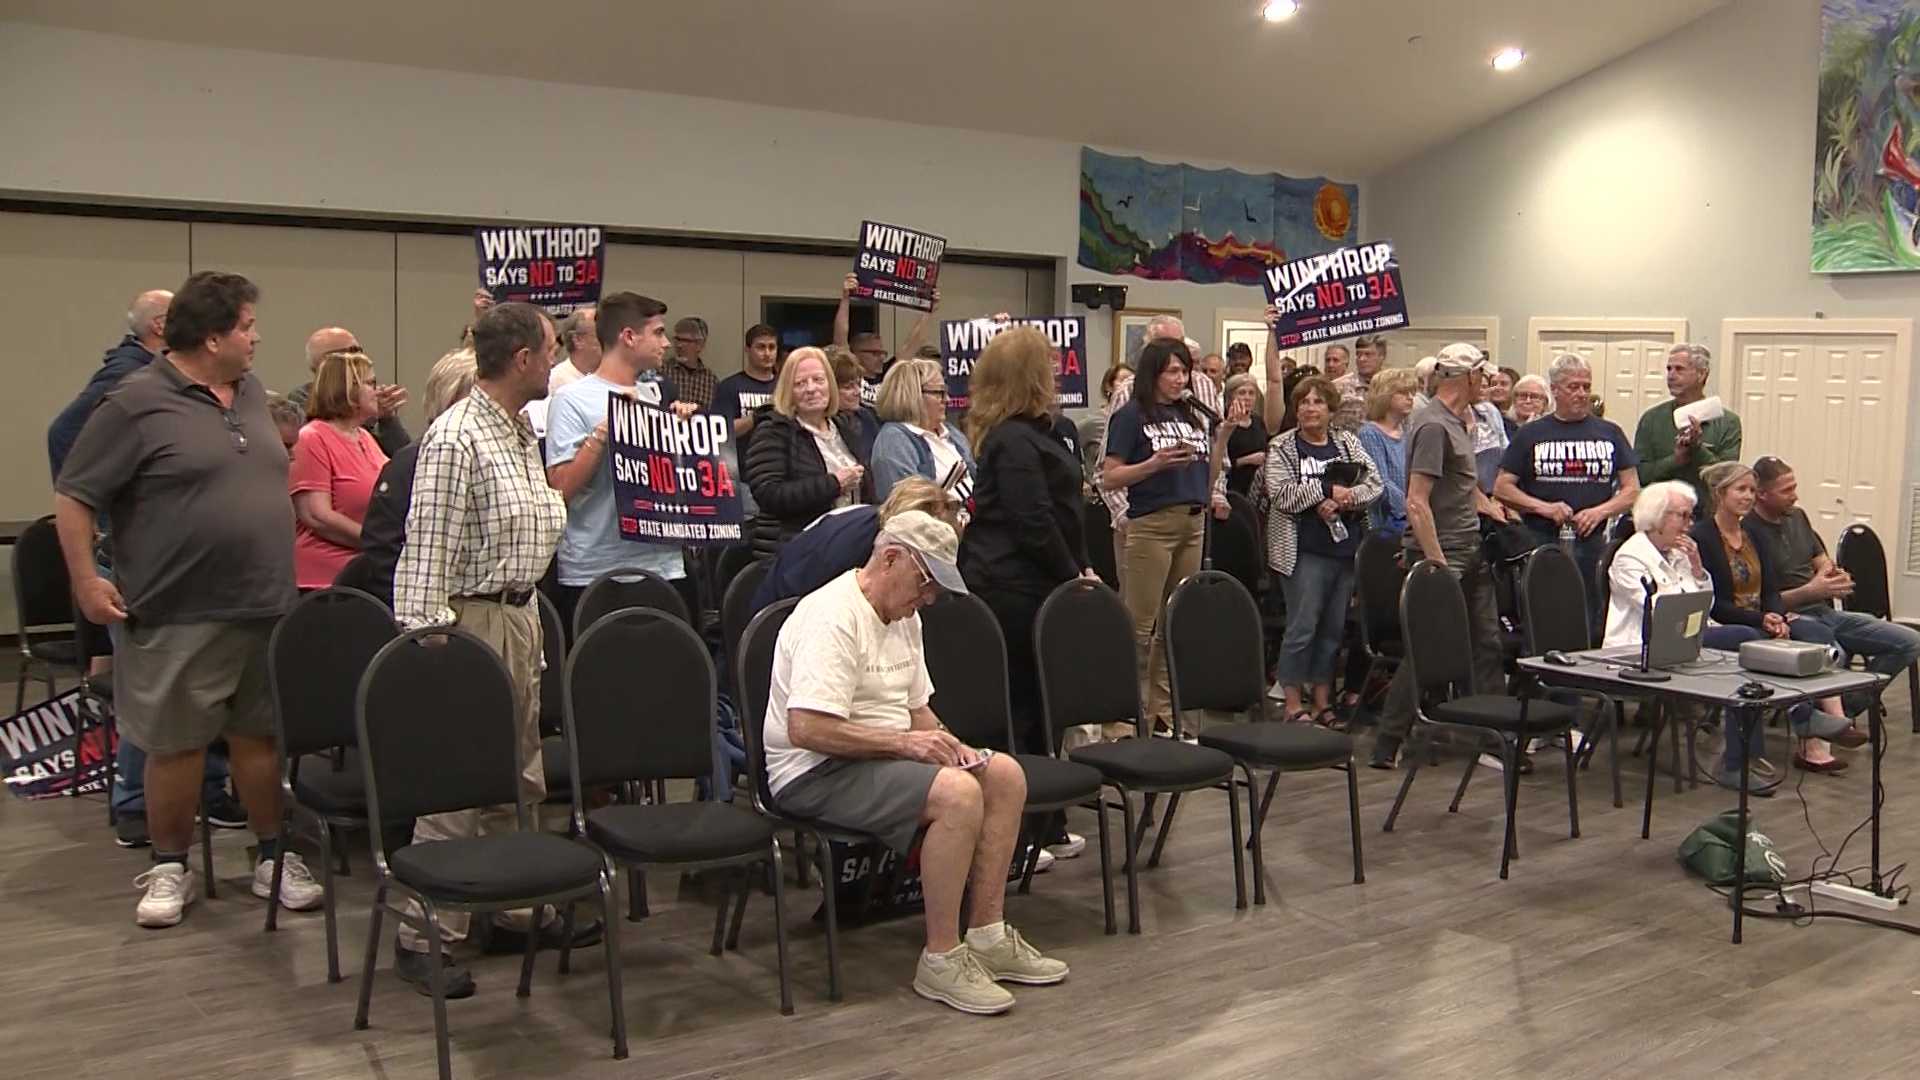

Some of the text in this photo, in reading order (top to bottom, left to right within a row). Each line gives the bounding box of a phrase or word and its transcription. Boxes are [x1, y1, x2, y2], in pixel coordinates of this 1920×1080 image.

[481, 228, 600, 260] WINTHROP
[865, 223, 944, 262] WINTHROP
[486, 259, 599, 287] SAYS NO TO 3A
[860, 252, 896, 273] SAYS
[896, 256, 917, 280] NO
[916, 265, 926, 280] TO
[1266, 243, 1392, 293] WINTHROP
[1275, 272, 1399, 315] SAYS NO TO 3A
[1301, 327, 1328, 341] STATE
[1329, 319, 1373, 336] MANDATED
[1056, 393, 1083, 403] ONING
[612, 397, 728, 456] WINTHROP
[1534, 440, 1615, 460] WINTHROP
[614, 452, 736, 498] SAYS NO TO 3A
[1534, 460, 1563, 475] SAYS
[1585, 461, 1600, 475] TO
[638, 520, 661, 537] STATE
[661, 521, 707, 539] MANDATED
[707, 523, 742, 539] ZONING
[15, 749, 76, 785] SAYS
